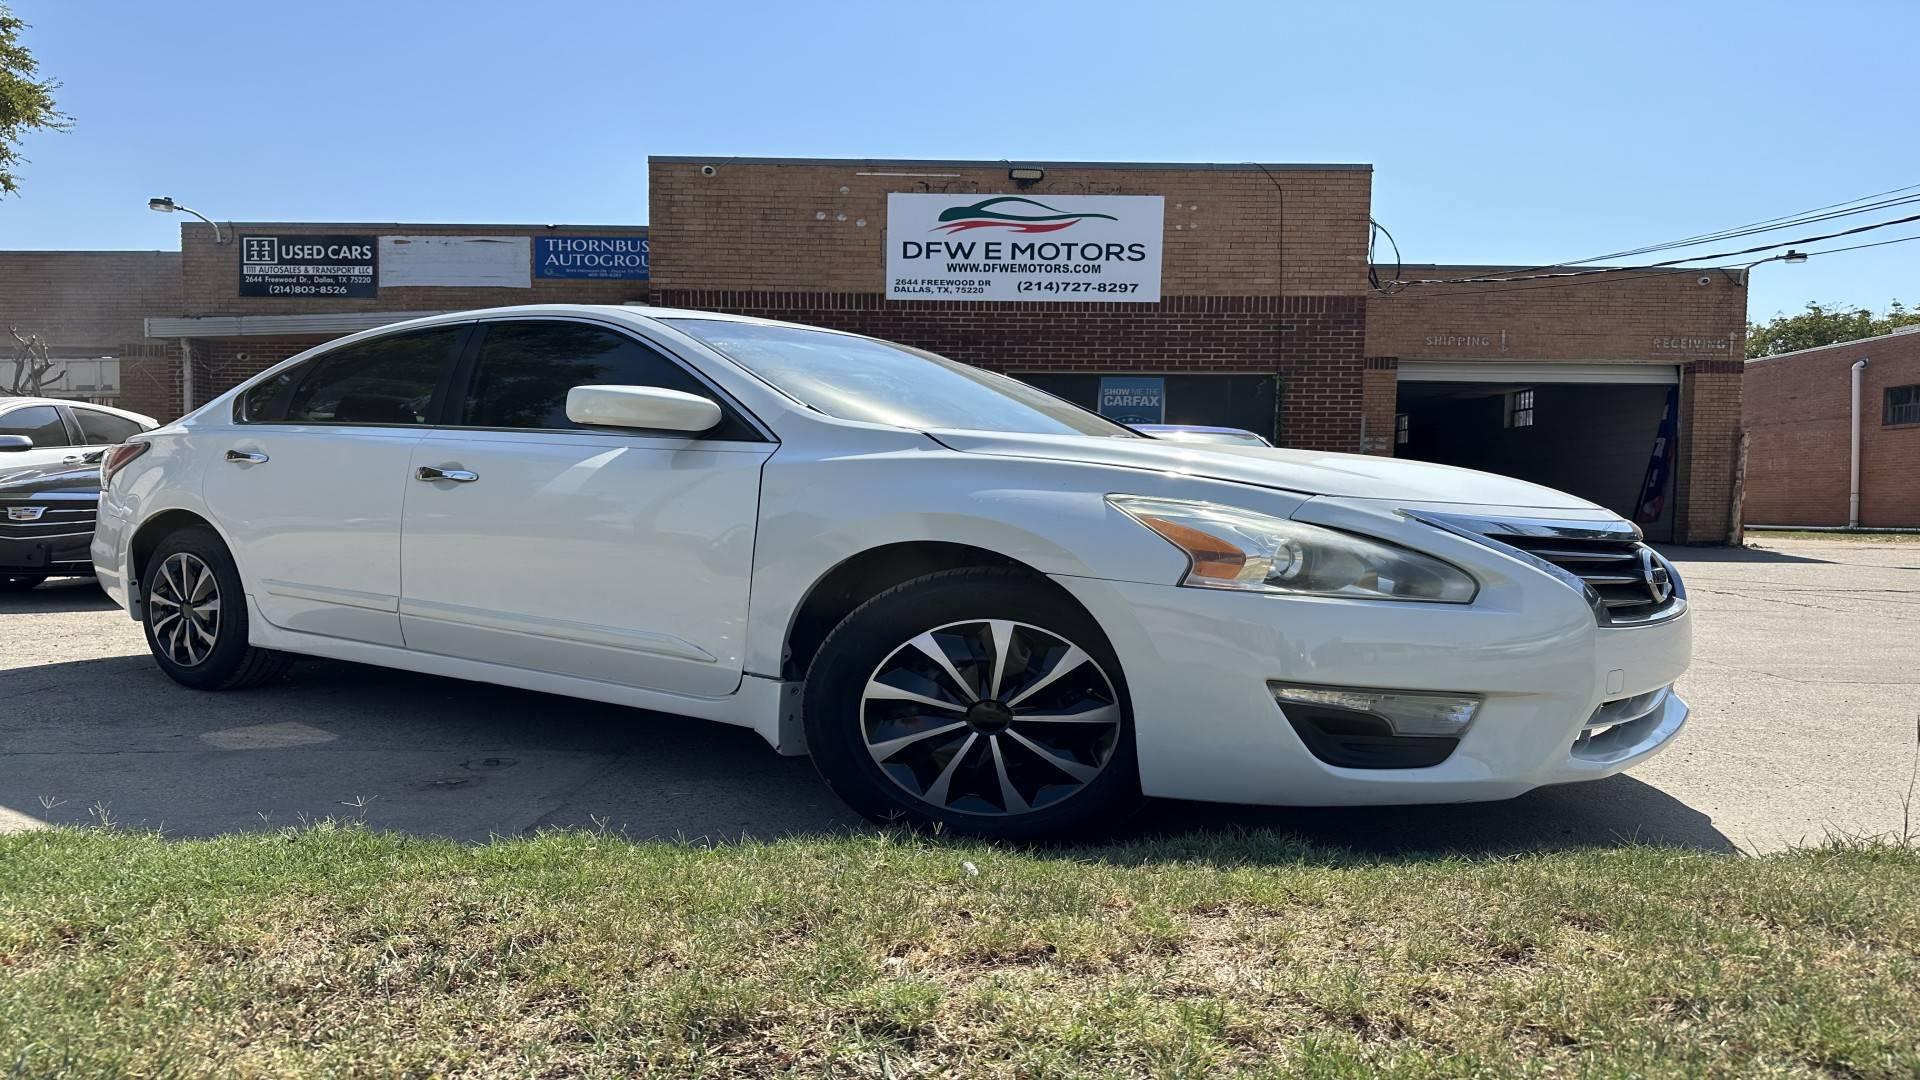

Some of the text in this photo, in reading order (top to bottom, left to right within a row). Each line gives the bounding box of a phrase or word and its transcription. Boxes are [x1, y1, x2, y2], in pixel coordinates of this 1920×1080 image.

[281, 245, 372, 259] USED CARS
[902, 241, 1146, 262] DFW E MOTORS
[259, 266, 302, 274] AUTOSALES
[304, 266, 309, 274] &
[312, 266, 356, 274] TRANSPORT
[946, 263, 1101, 274] WWW.DFWEMOTORS.COM
[350, 276, 372, 284] 75220
[269, 285, 347, 294] (214)803-8526
[894, 286, 934, 294] DALLAS,
[1017, 281, 1139, 294] (214)727-8297
[1425, 335, 1489, 346] SHIPPING
[1103, 388, 1130, 396] SHOW
[1103, 395, 1160, 407] CARFAX
